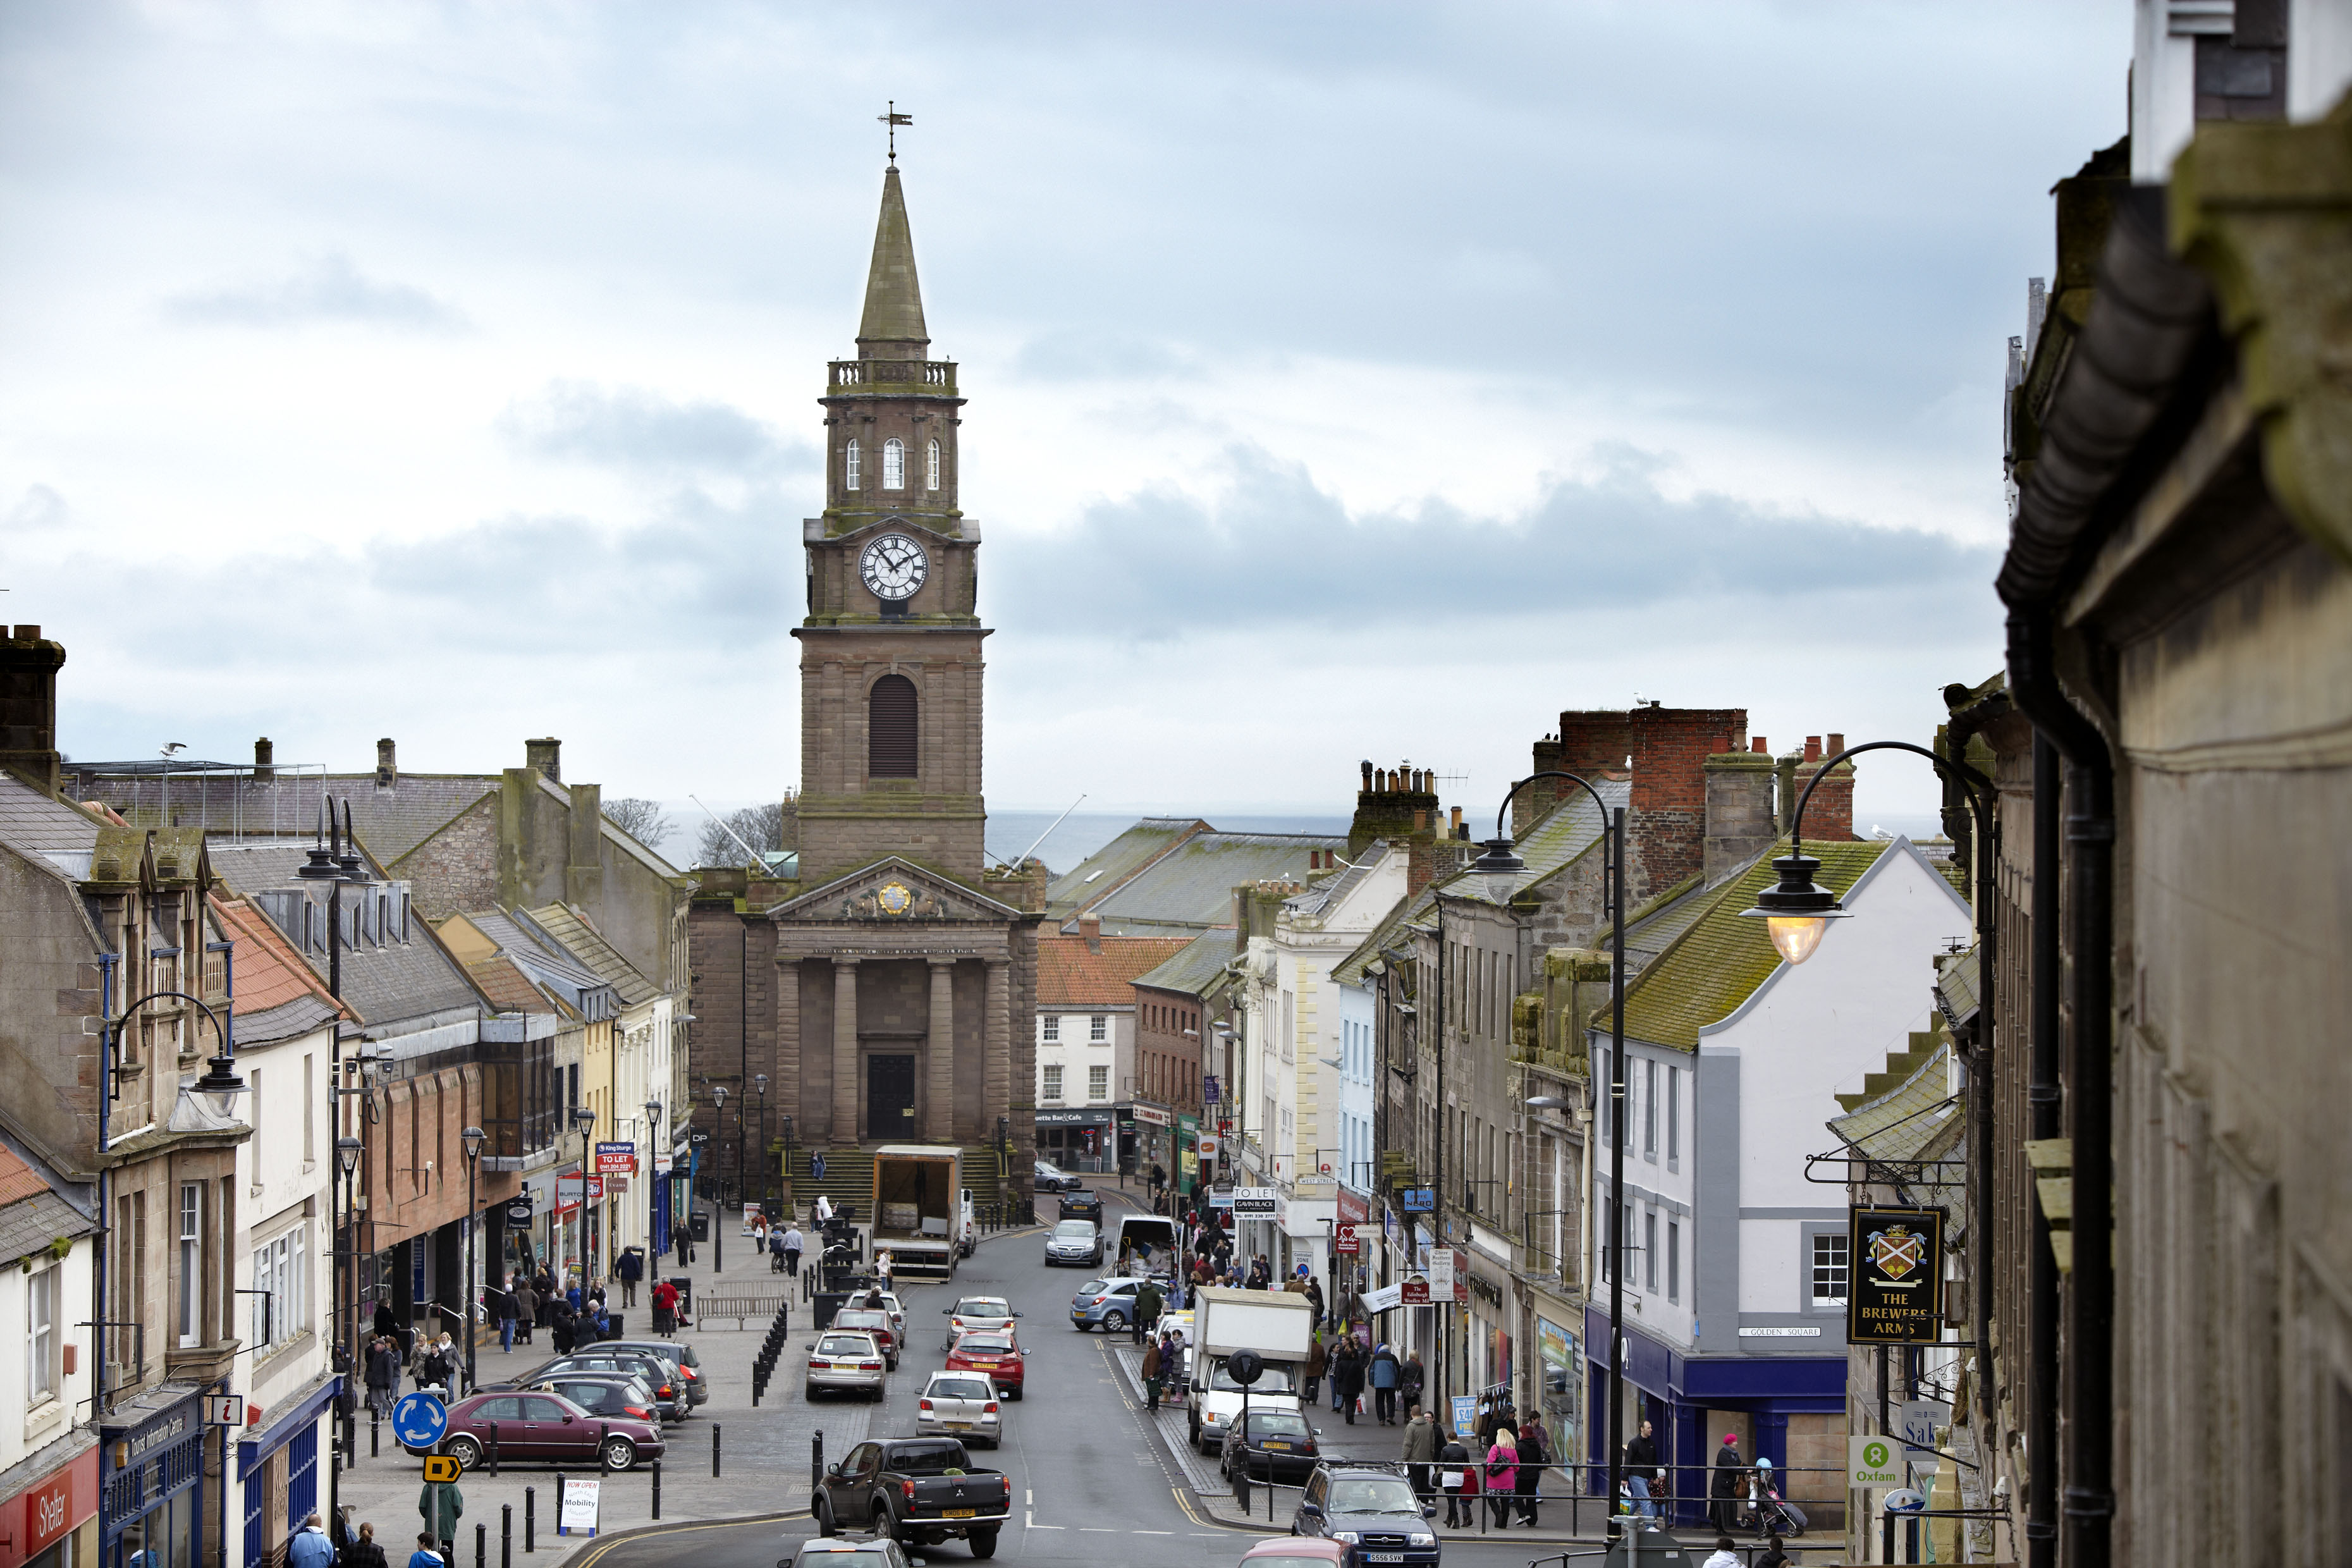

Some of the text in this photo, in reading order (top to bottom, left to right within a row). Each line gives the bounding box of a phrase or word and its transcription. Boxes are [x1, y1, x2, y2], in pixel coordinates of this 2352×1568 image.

[1235, 1189, 1251, 1197] TO
[1258, 1189, 1275, 1197] LET
[1882, 1294, 1908, 1304] THE
[1862, 1308, 1927, 1320] BREWERS
[132, 1436, 145, 1457] Tourist
[147, 1424, 168, 1449] Information
[169, 1416, 183, 1437] Centre
[1856, 1471, 1896, 1481] Oxfam
[565, 1499, 596, 1509] Mobility
[39, 1488, 66, 1538] Shelter
[568, 1508, 592, 1516] Solutions
